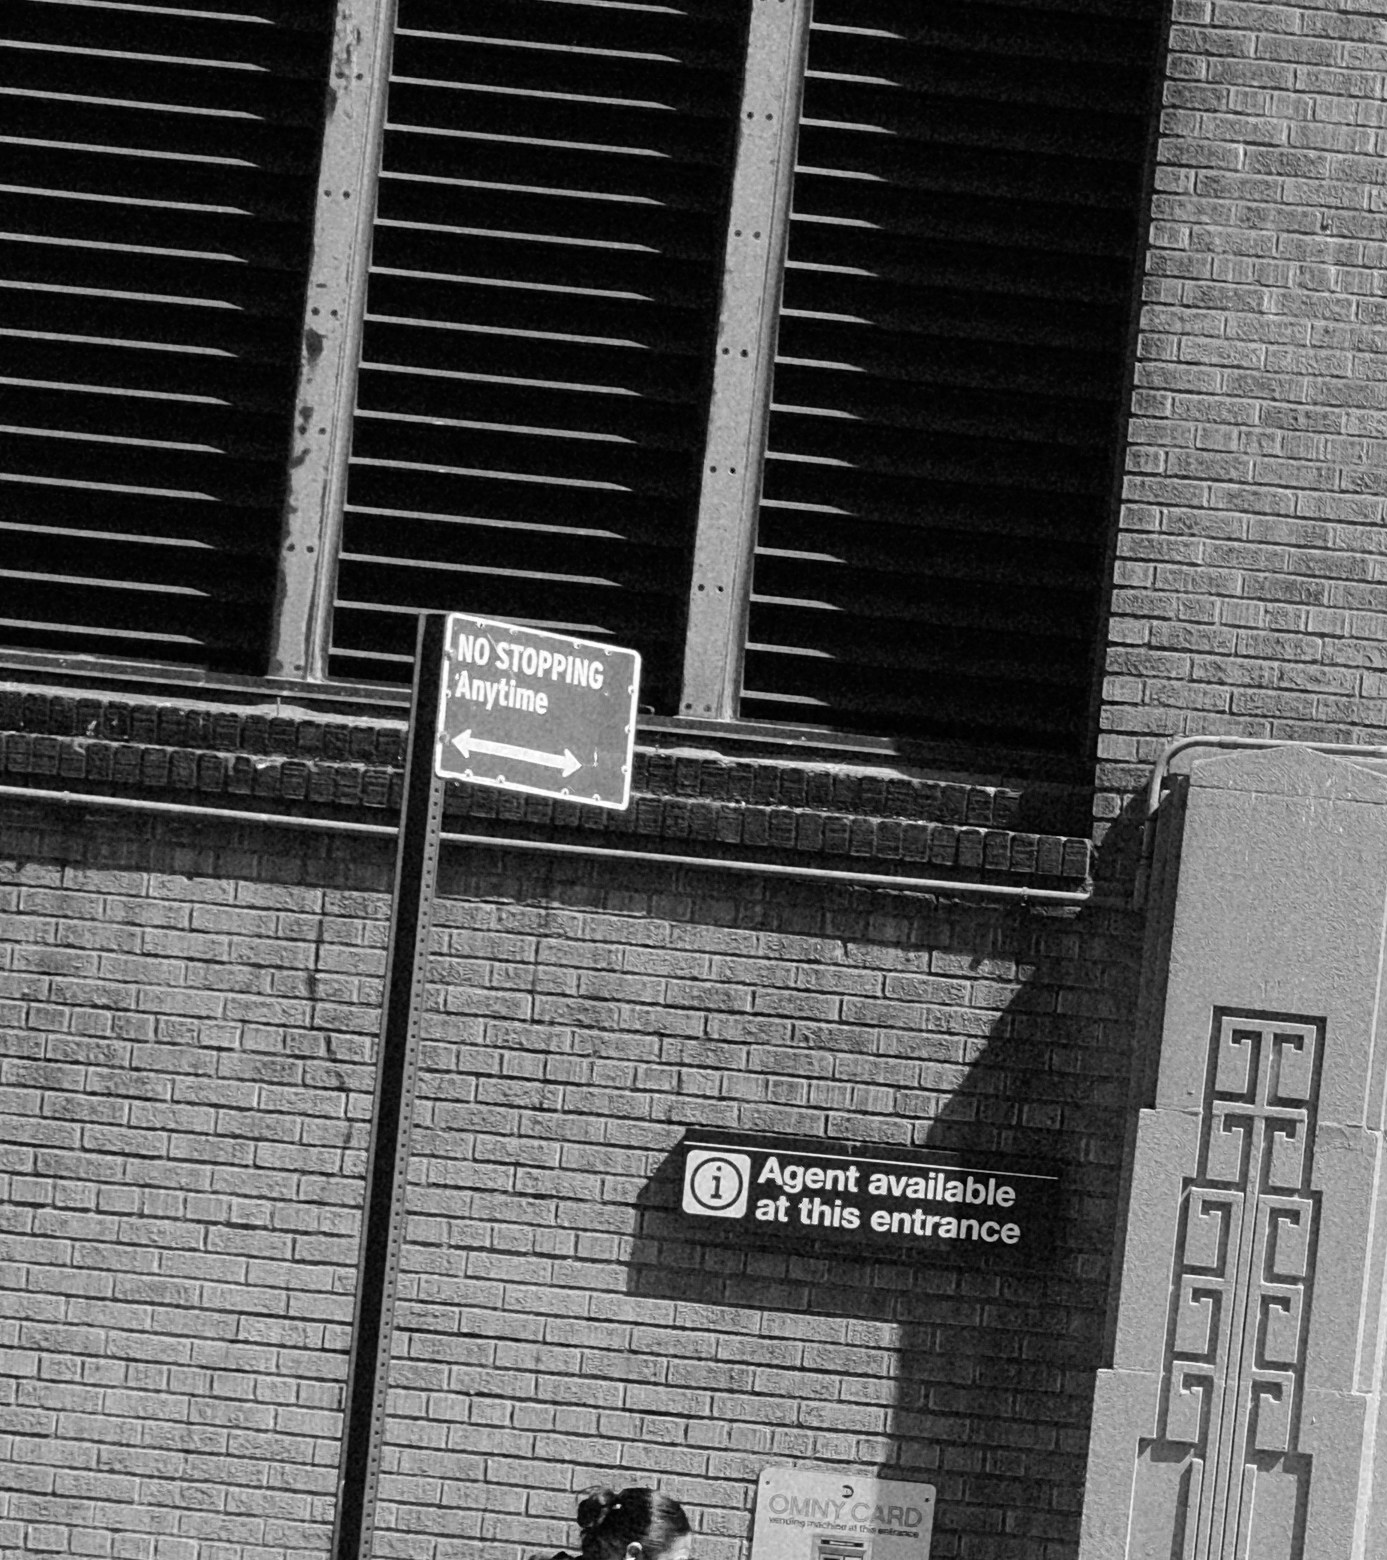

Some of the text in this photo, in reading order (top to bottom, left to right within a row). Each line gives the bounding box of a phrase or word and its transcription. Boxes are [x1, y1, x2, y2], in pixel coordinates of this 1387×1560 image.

[456, 633, 604, 690] NO STOPPING
[455, 670, 549, 715] Anytime
[756, 1156, 1017, 1208] Agent available
[755, 1195, 1022, 1245] at this entrance
[768, 1493, 923, 1528] OMNY CARD
[768, 1516, 806, 1528] vending
[859, 1524, 876, 1535] this
[877, 1526, 920, 1539] entrance
